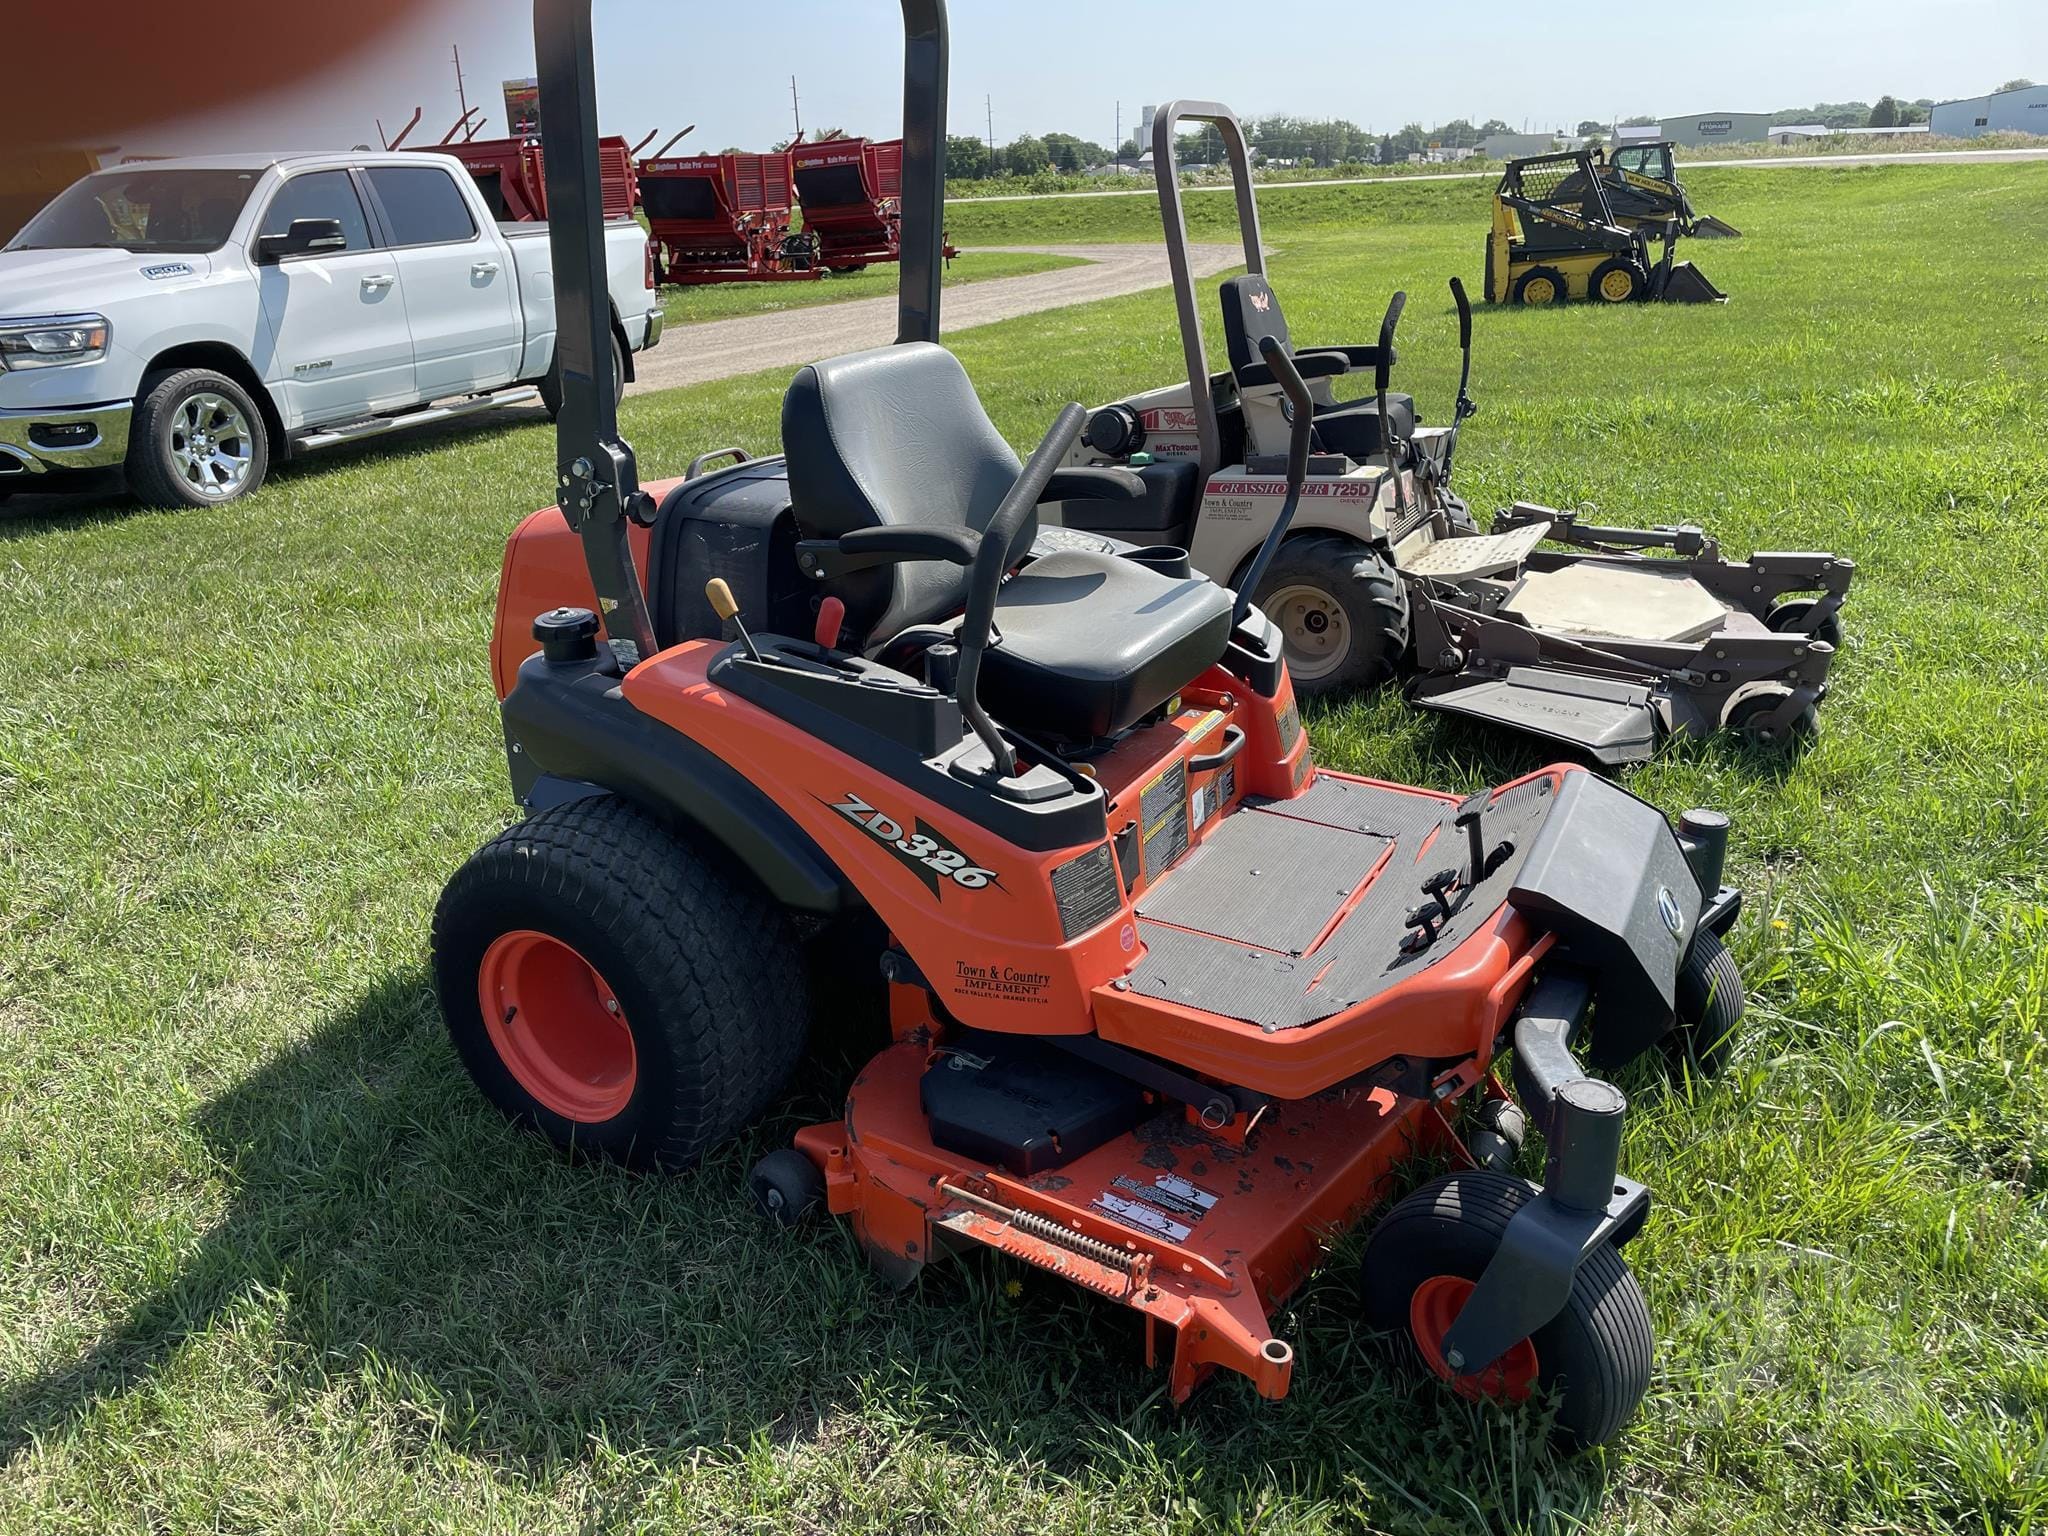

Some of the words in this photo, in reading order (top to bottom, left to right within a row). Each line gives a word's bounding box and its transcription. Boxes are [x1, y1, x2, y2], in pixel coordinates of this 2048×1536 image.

[294, 359, 332, 371] RAM
[1332, 483, 1371, 496] 725D
[1229, 499, 1253, 510] Country
[829, 792, 999, 890] ZD326
[956, 960, 986, 978] Town
[990, 965, 999, 980] &
[1003, 967, 1051, 988] Country
[964, 979, 1040, 996] IMPLEMENT
[1136, 1201, 1167, 1217] DANGER
